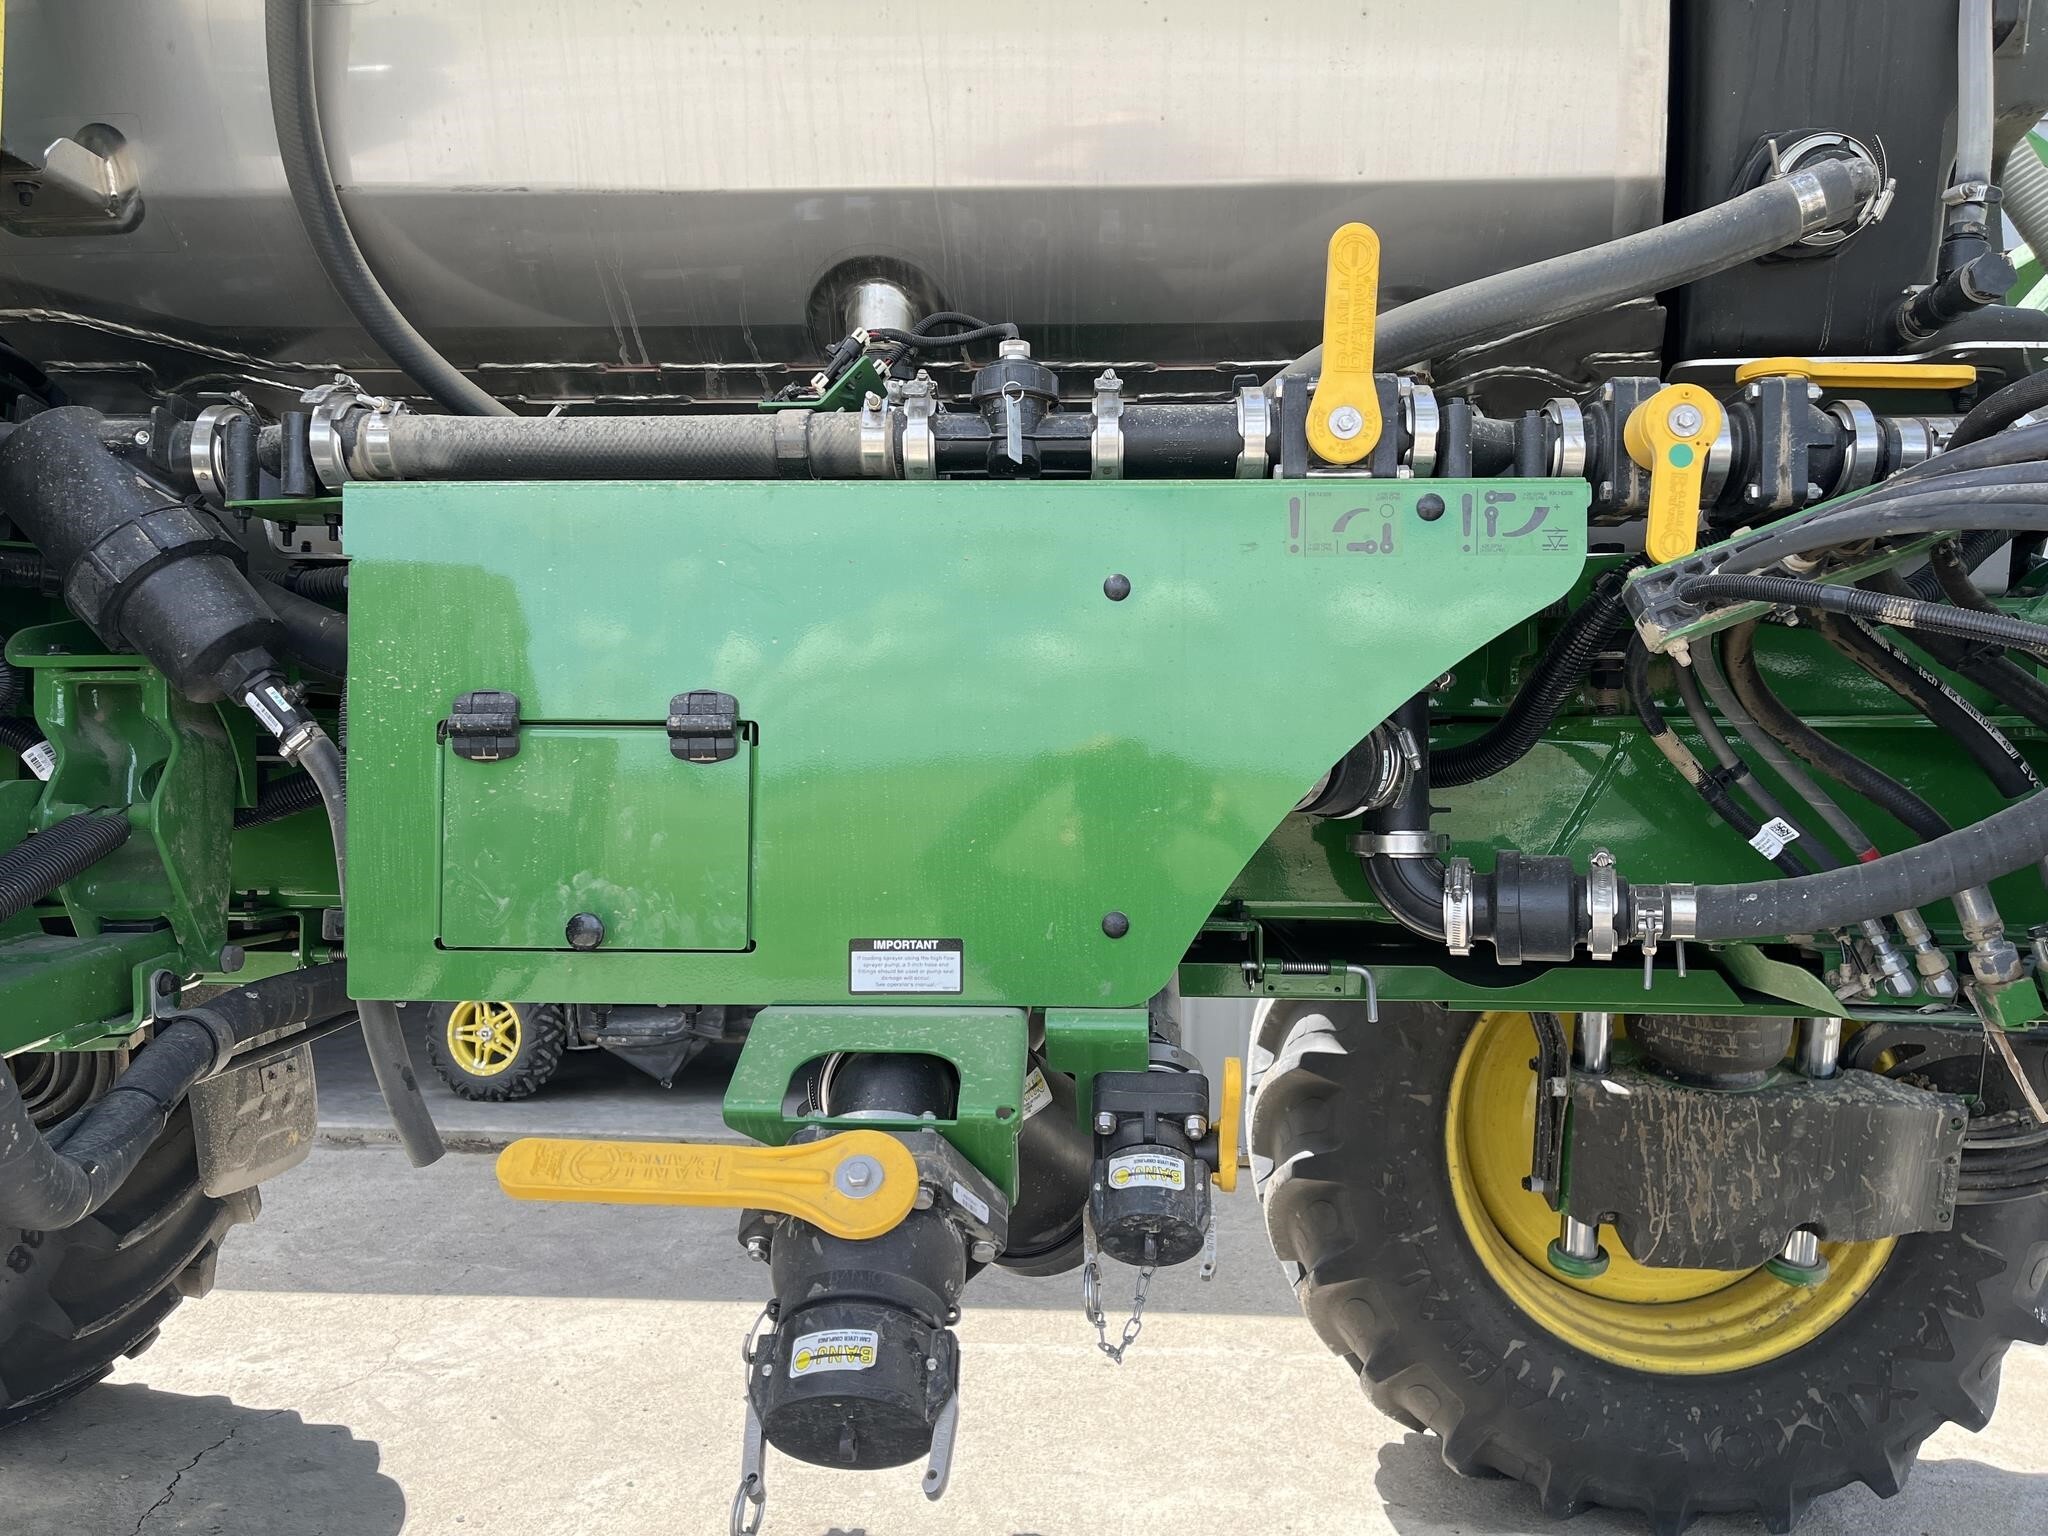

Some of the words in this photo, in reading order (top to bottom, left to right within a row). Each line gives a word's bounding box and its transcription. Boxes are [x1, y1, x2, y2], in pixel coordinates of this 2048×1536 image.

[1334, 233, 1377, 370] BANJO
[1959, 698, 1997, 734] MINETUFF
[873, 940, 939, 950] IMPORTANT
[569, 1143, 722, 1185] BANJO
[1111, 1166, 1182, 1186] BANJO
[1206, 1223, 1216, 1251] BANJO
[793, 1346, 873, 1374] BANJO
